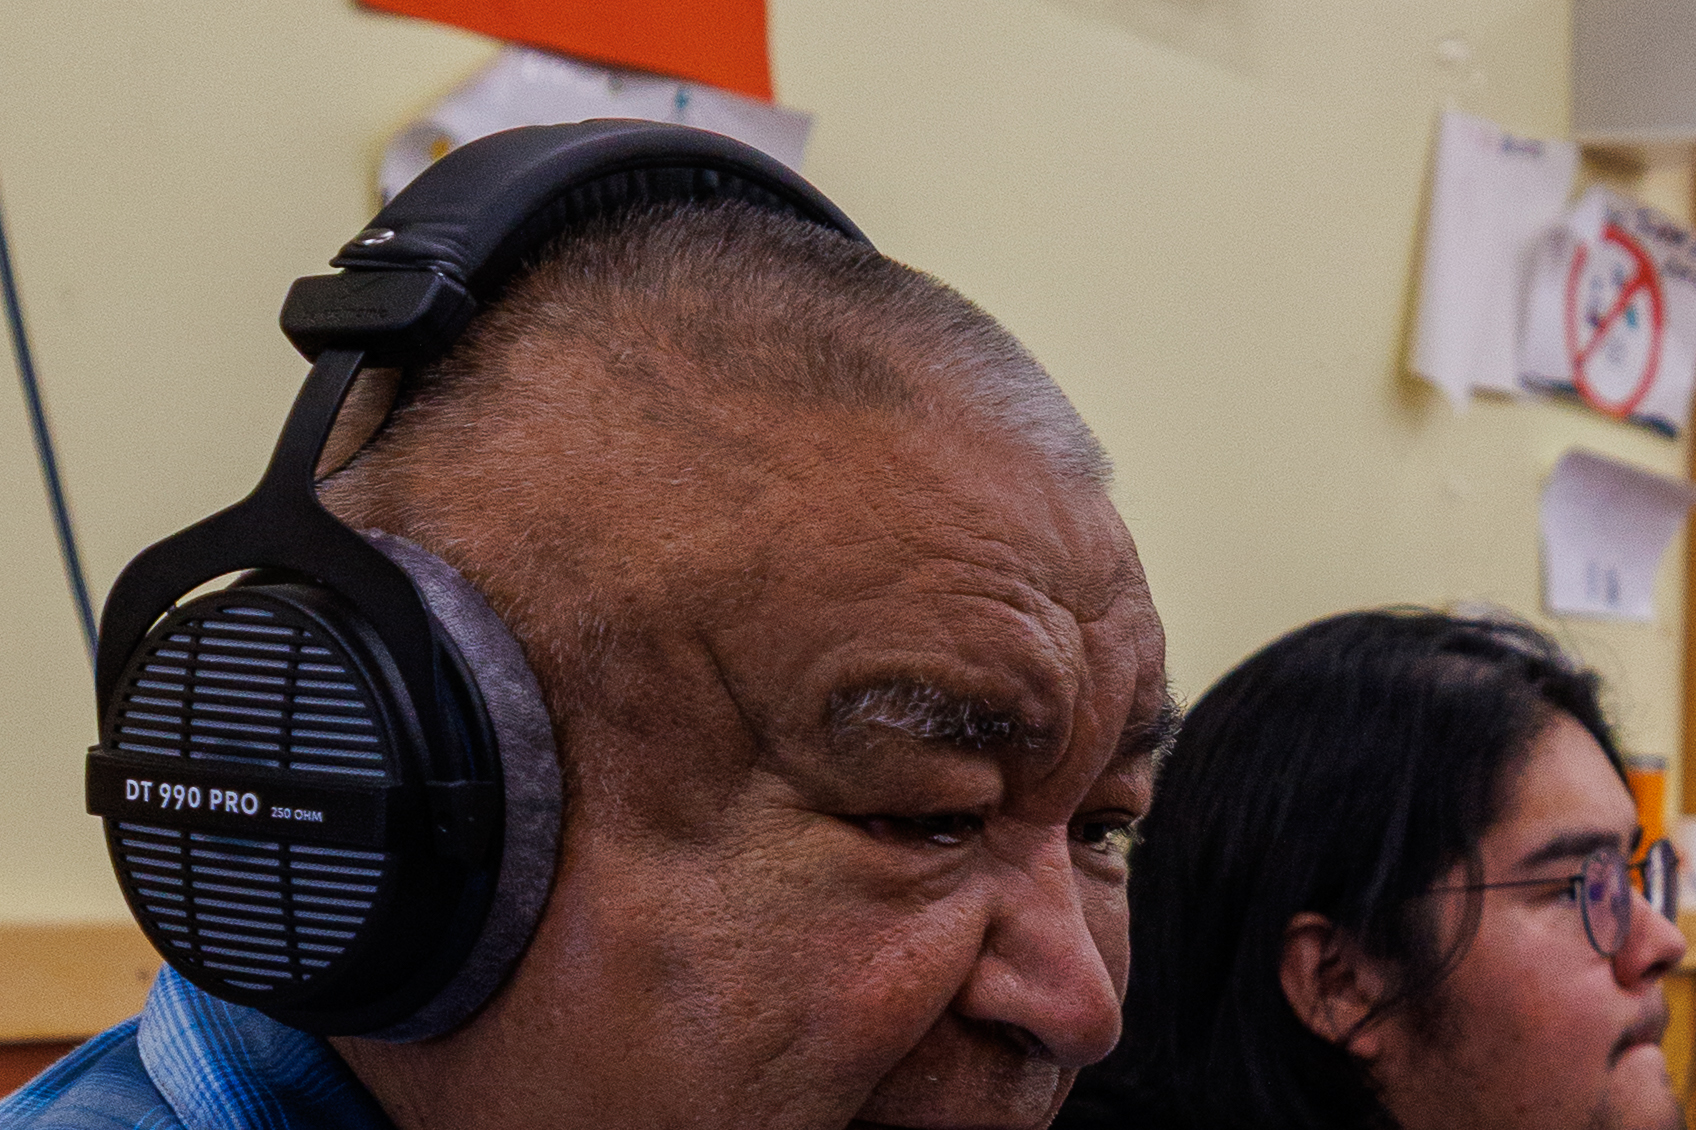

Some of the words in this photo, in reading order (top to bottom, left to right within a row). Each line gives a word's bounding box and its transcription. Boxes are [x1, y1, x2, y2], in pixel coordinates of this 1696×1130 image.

[125, 778, 154, 802] DT
[158, 782, 201, 810] 990
[209, 788, 259, 815] PRO
[270, 806, 292, 820] 250
[294, 808, 323, 823] OHM
